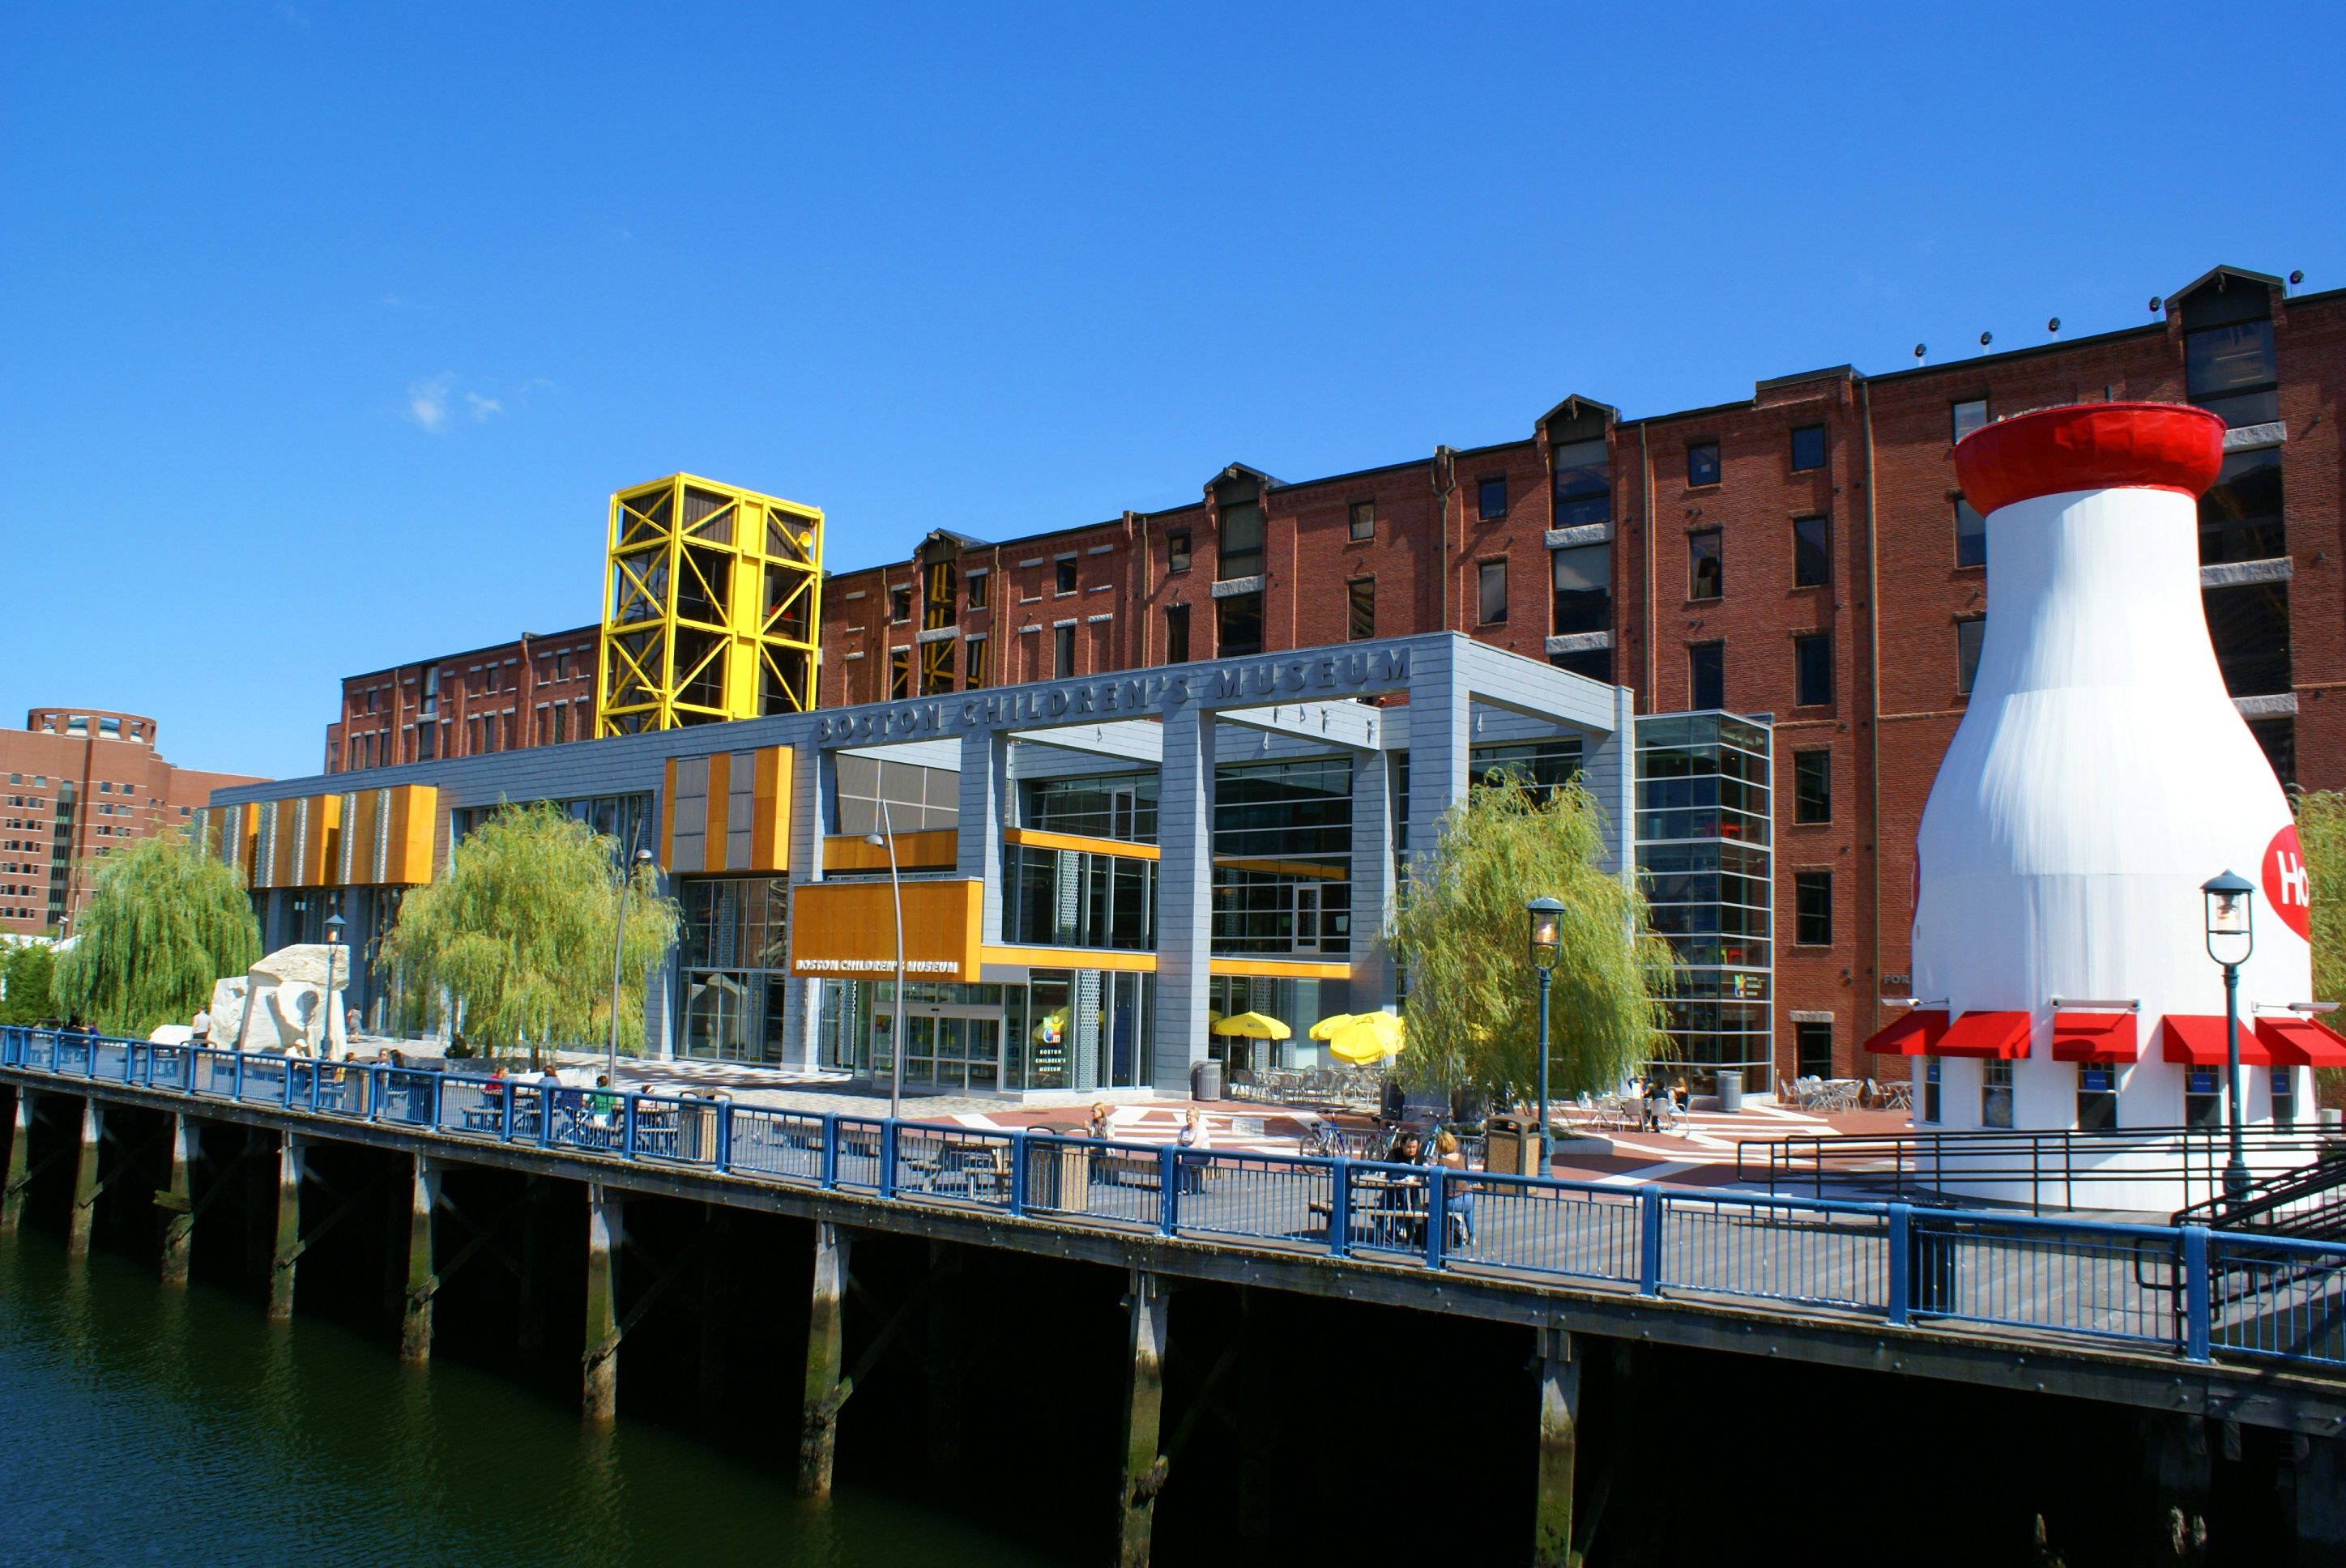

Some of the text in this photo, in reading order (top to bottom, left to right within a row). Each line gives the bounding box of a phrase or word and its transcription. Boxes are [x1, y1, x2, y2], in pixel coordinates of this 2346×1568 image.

[817, 646, 1413, 742] BOSTON CHILDREN'S MUSEUM
[796, 960, 958, 973] BOSTON CHILDREN' MUSEUM
